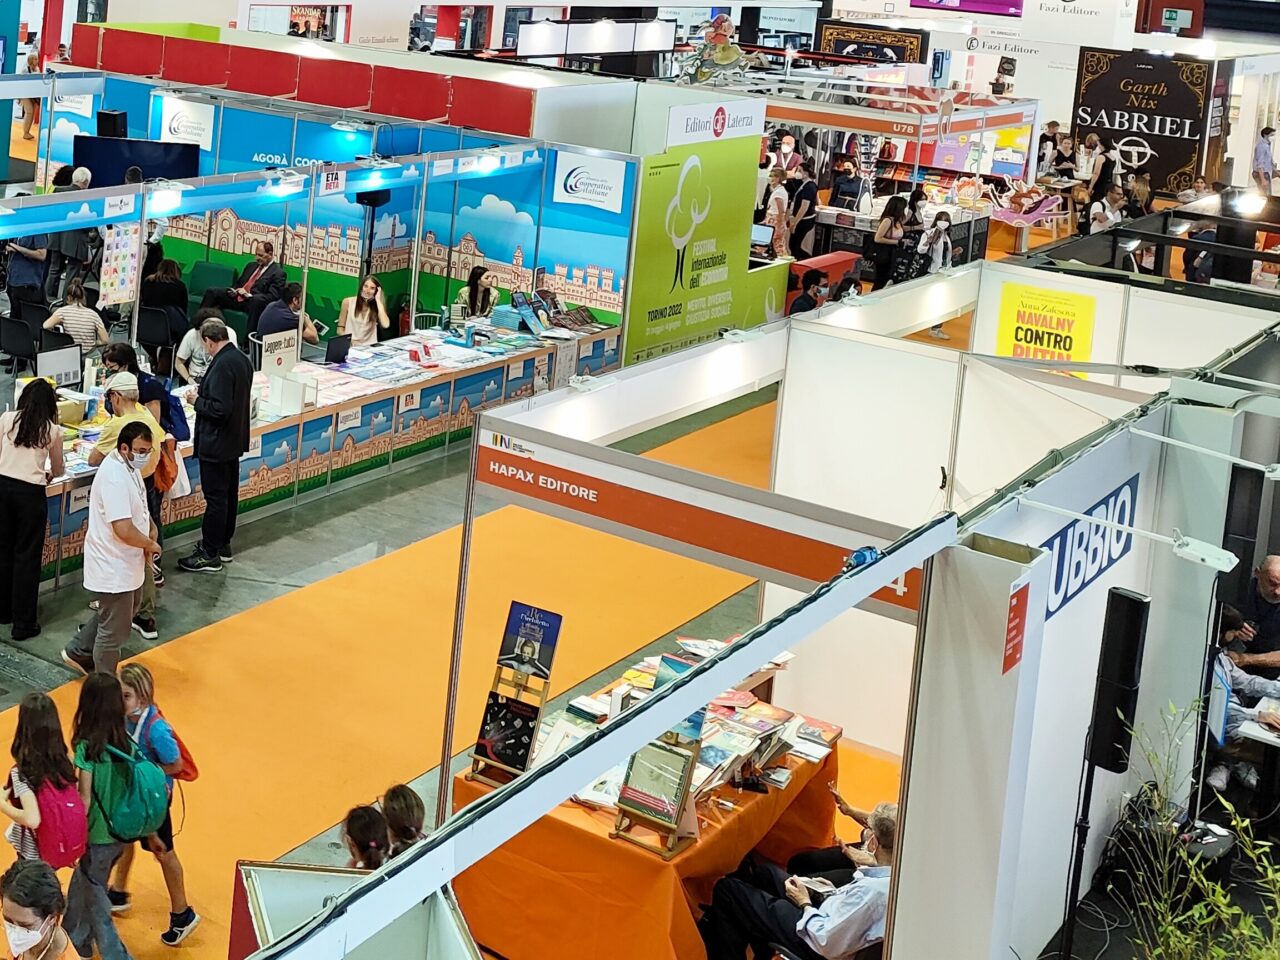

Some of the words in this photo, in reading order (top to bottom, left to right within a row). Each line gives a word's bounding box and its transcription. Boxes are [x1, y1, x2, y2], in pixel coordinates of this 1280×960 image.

[1039, 2, 1059, 14] Fazi
[1063, 4, 1101, 18] Editore
[982, 41, 1002, 51] Fazi
[1004, 42, 1040, 55] Editore
[1120, 79, 1168, 97] Garth
[1126, 94, 1158, 110] Nix
[685, 116, 712, 134] Editori
[727, 114, 753, 129] Laterza
[893, 123, 914, 135] U78
[1076, 106, 1201, 140] SABRIEL
[252, 153, 288, 166] AGORÀ
[326, 172, 339, 182] ETA
[325, 182, 339, 191] BETA
[691, 252, 727, 272] internazionale
[648, 306, 667, 322] TORINO
[668, 303, 683, 318] 2022
[1018, 300, 1040, 310] Anna
[1016, 310, 1075, 333] NAVALNY
[1014, 326, 1074, 352] CONTRO
[489, 461, 535, 484] HAPAX
[538, 475, 598, 502] EDITORE
[1047, 485, 1132, 613] UBBIO
